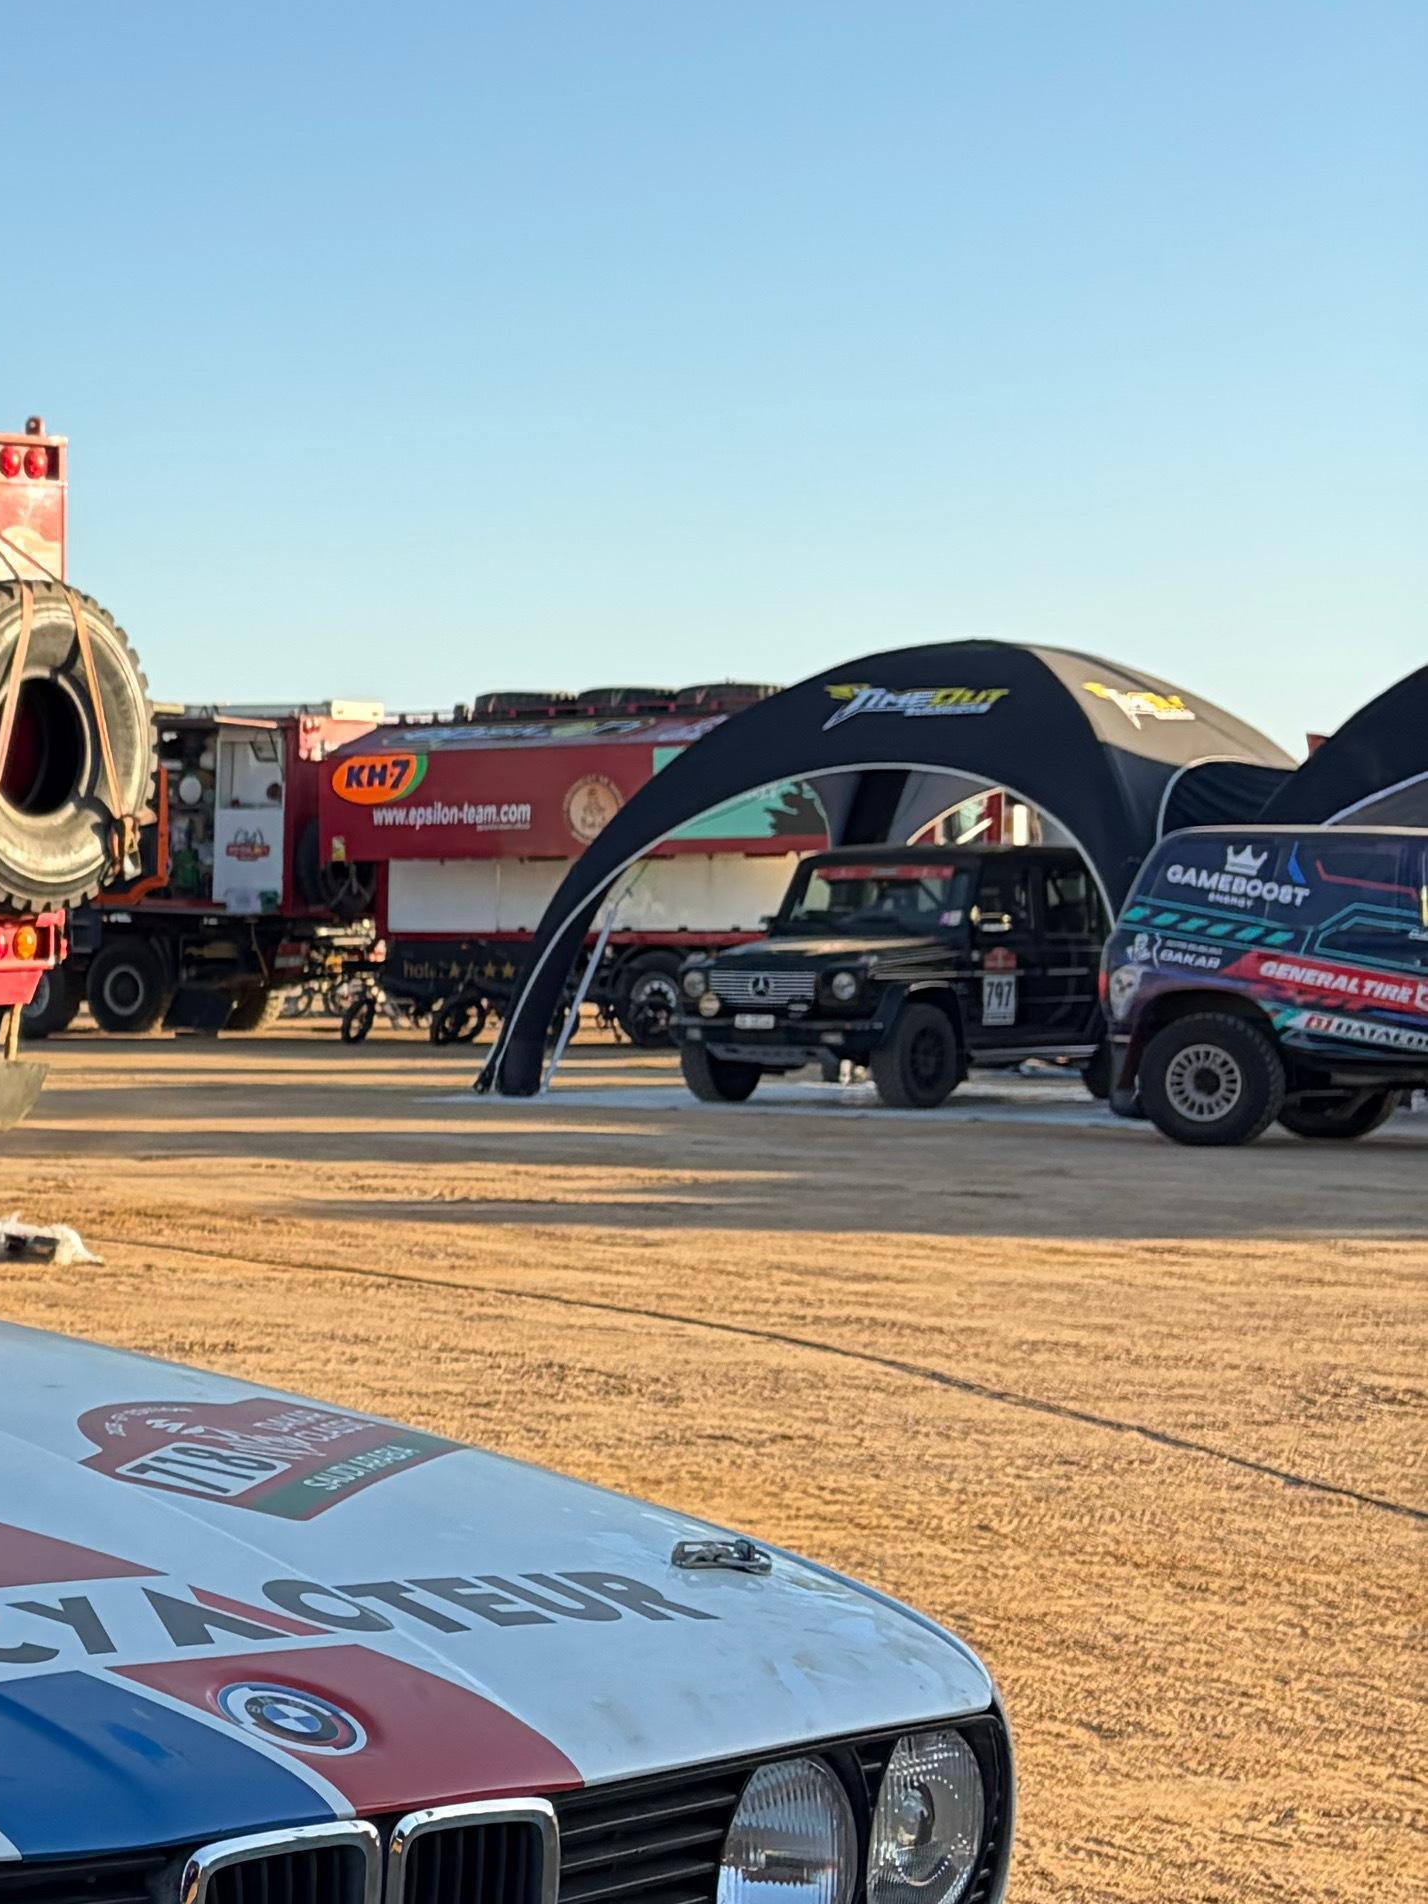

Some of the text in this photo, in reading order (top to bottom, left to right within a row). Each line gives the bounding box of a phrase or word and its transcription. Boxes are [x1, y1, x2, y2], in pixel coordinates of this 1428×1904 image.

[373, 803, 531, 830] www.epsilon-team.com
[1166, 864, 1311, 907] GAMEBOOST
[1159, 948, 1221, 969] DAKAR
[986, 981, 1014, 1008] 797
[1259, 960, 1415, 1004] GENERAL TIRE
[126, 1445, 279, 1495] 718
[141, 1571, 720, 1647] MOTEUR
